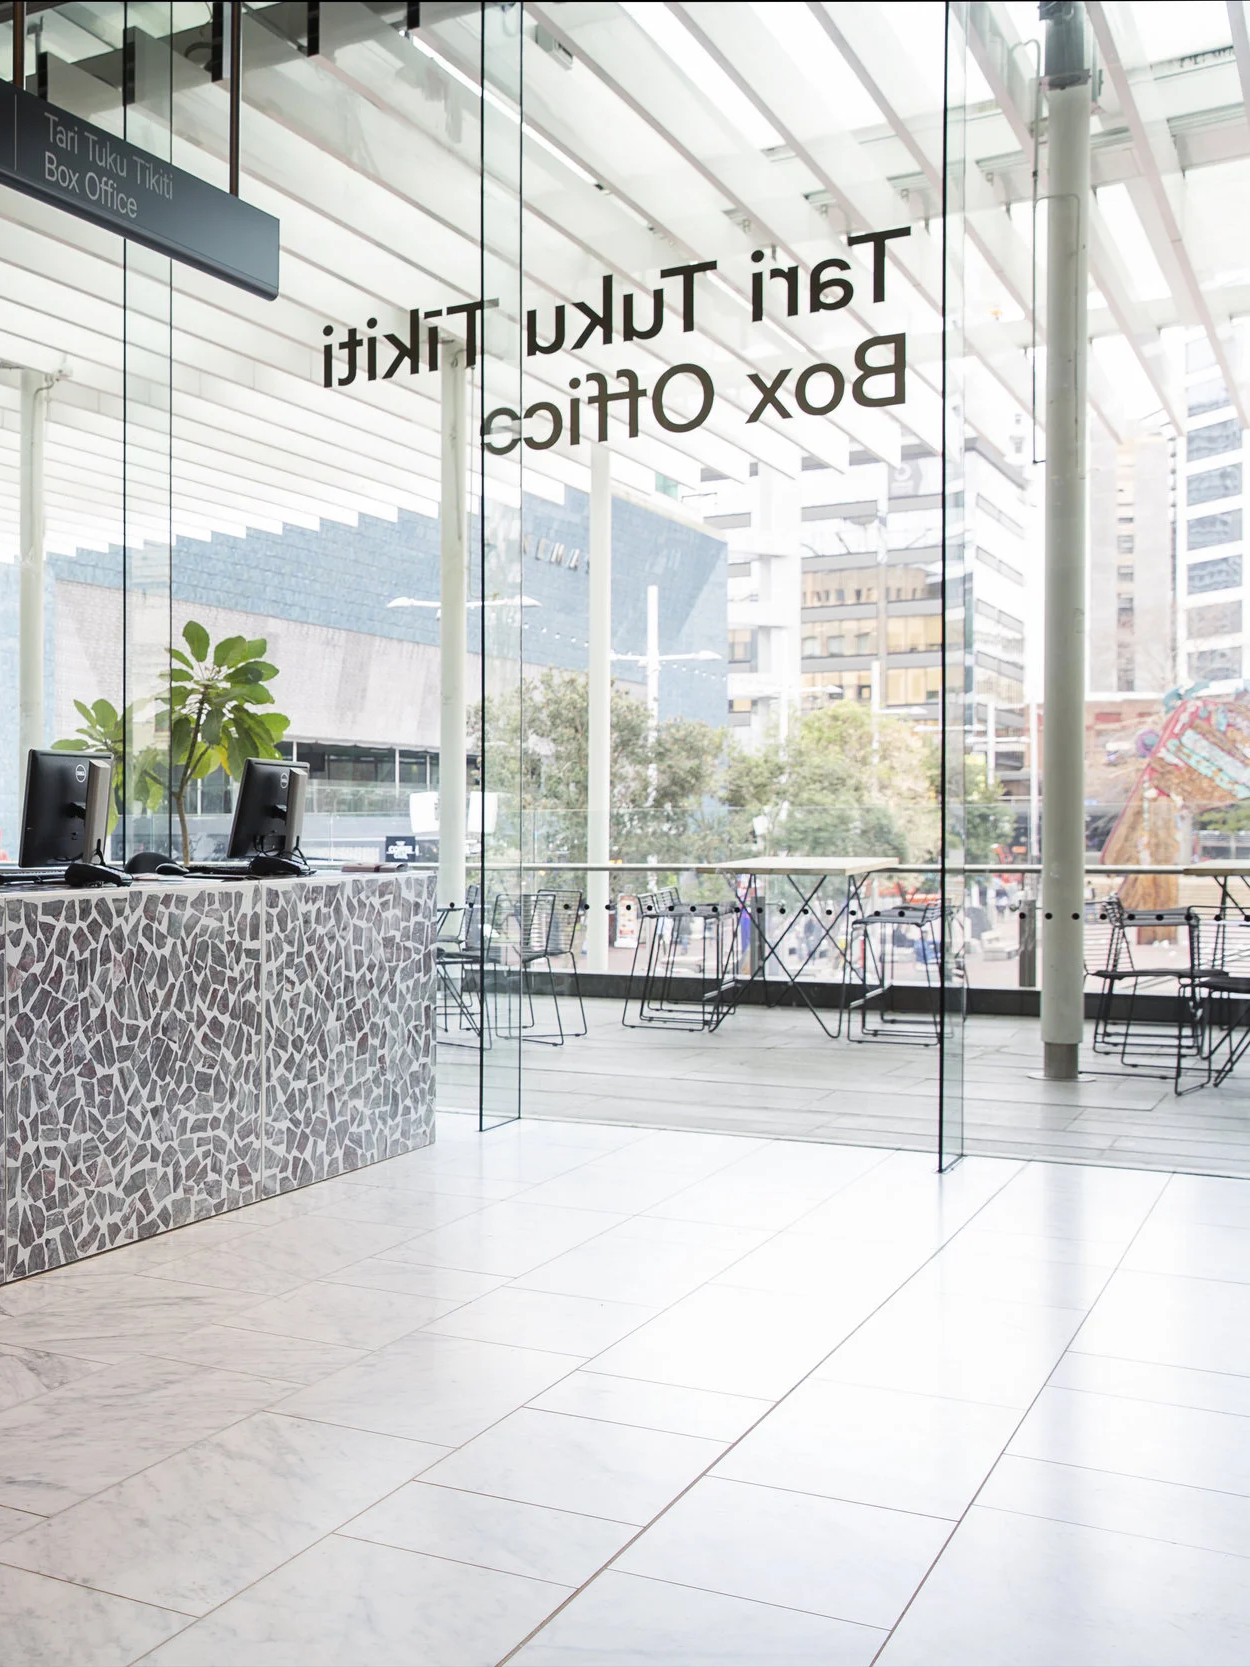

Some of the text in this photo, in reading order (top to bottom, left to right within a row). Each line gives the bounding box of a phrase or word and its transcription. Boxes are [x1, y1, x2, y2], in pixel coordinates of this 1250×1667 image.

[44, 111, 79, 155] Tari
[84, 131, 128, 178] Tuku
[44, 151, 138, 218] Box Office
